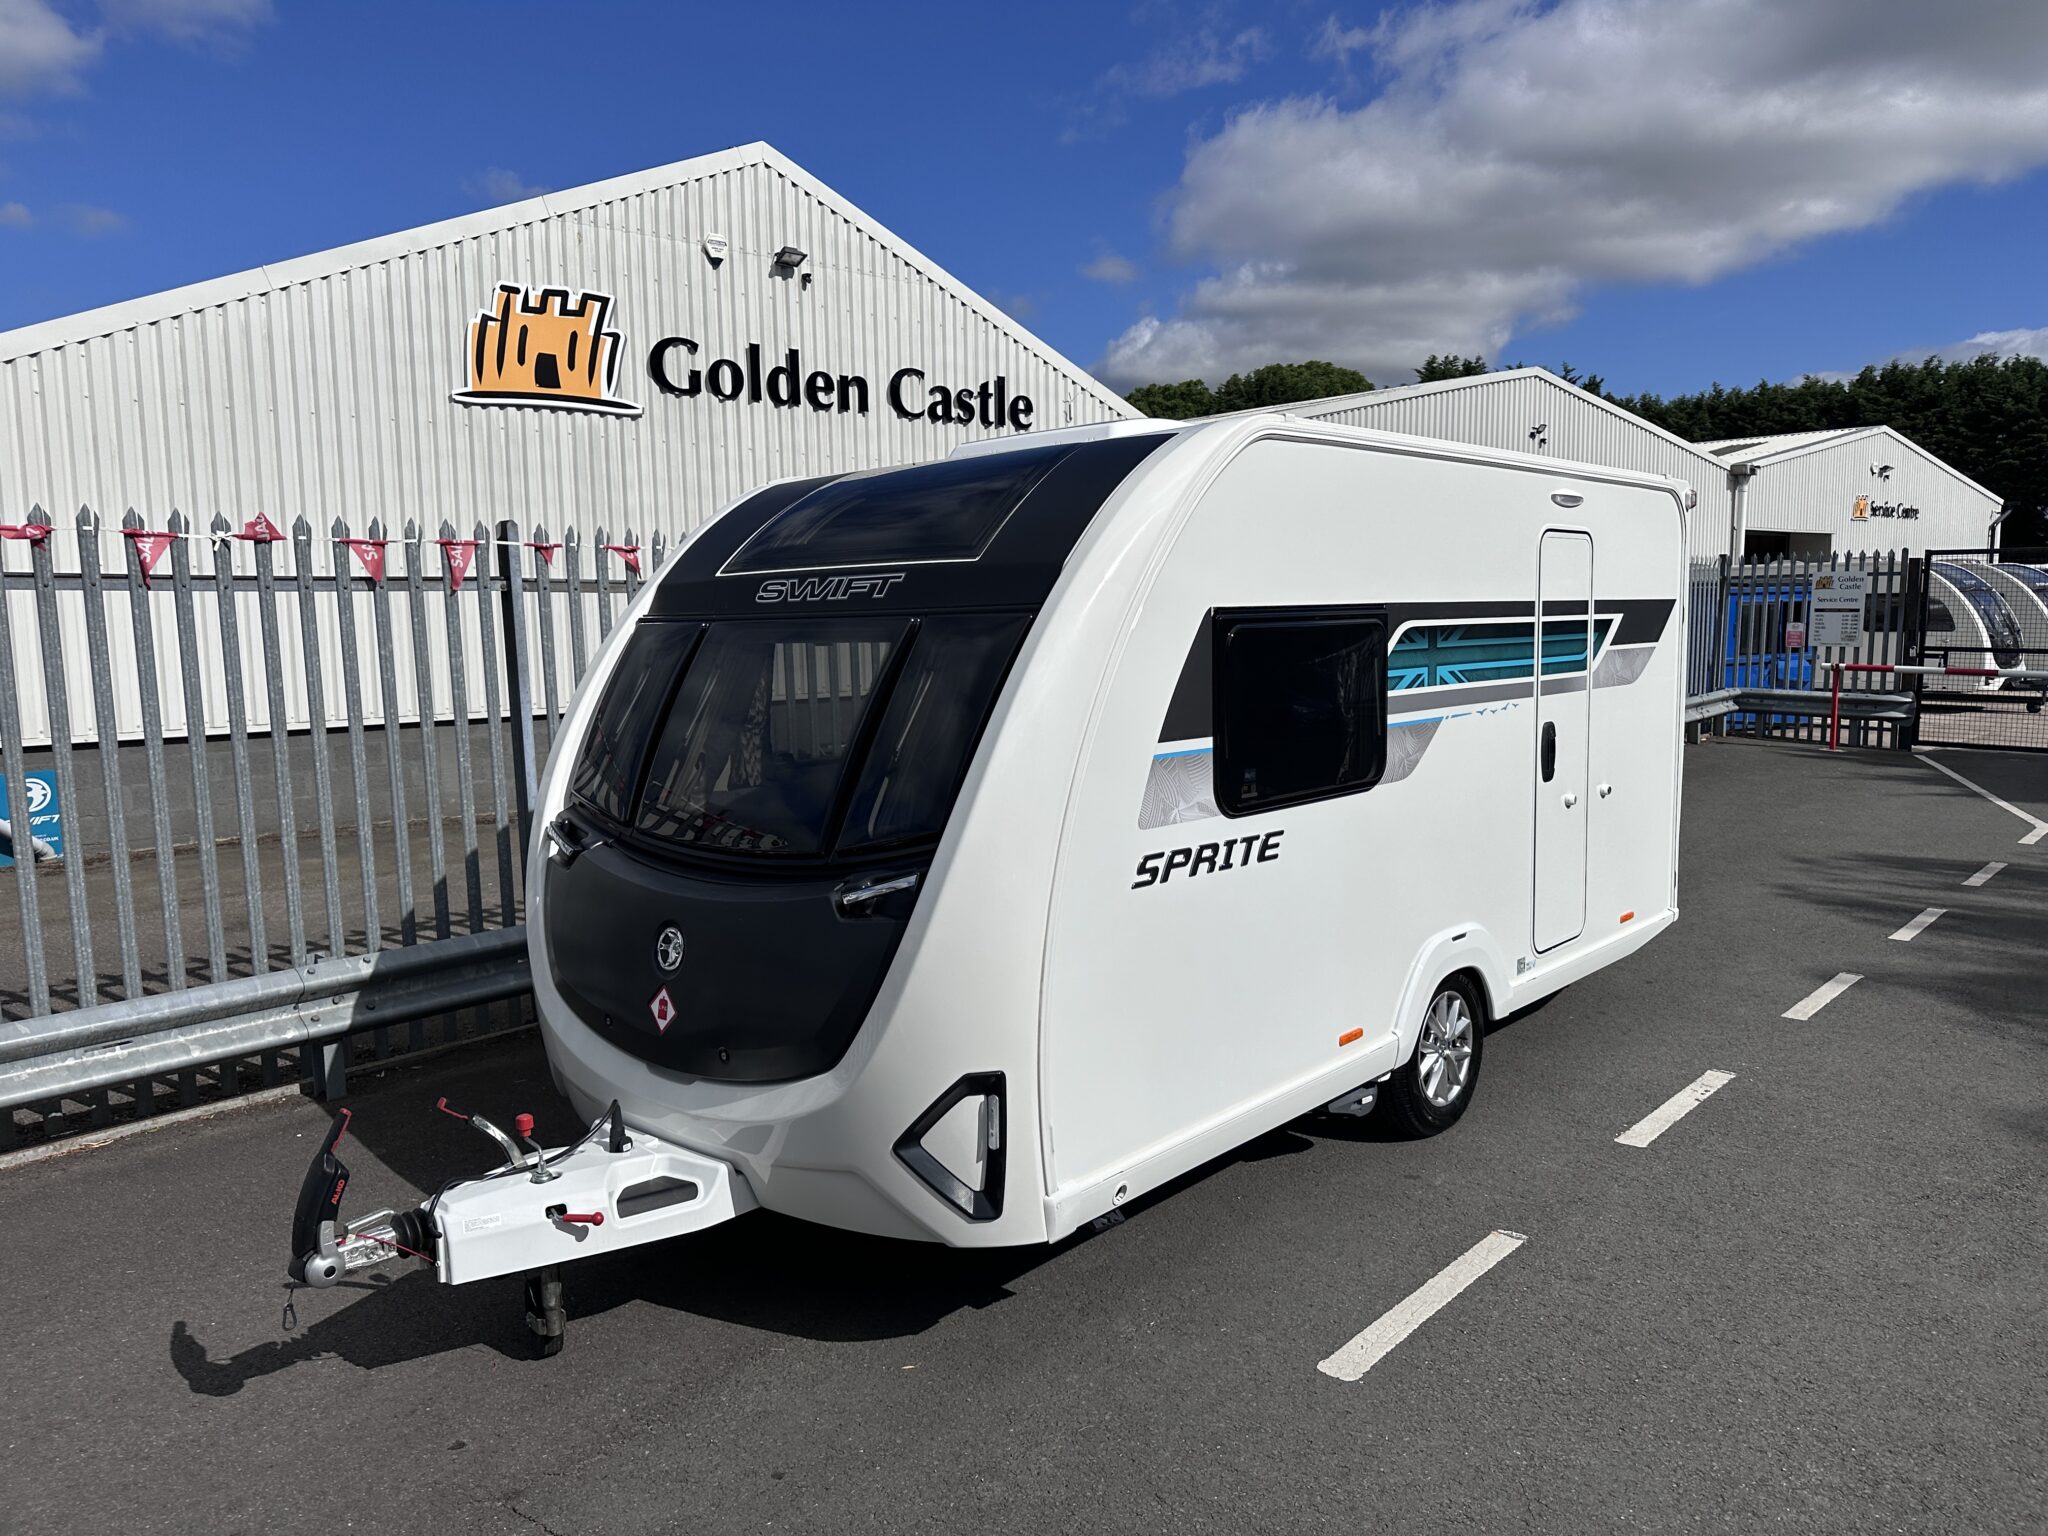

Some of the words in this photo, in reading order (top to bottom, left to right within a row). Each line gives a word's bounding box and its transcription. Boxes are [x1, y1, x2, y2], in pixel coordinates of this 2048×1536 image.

[648, 337, 869, 414] Golden
[888, 368, 1033, 430] Castle
[1870, 500, 1896, 518] Service
[1897, 502, 1920, 520] Centre
[755, 573, 906, 602] SWIFT
[1837, 575, 1864, 583] Golden
[1131, 830, 1284, 890] SPRITE
